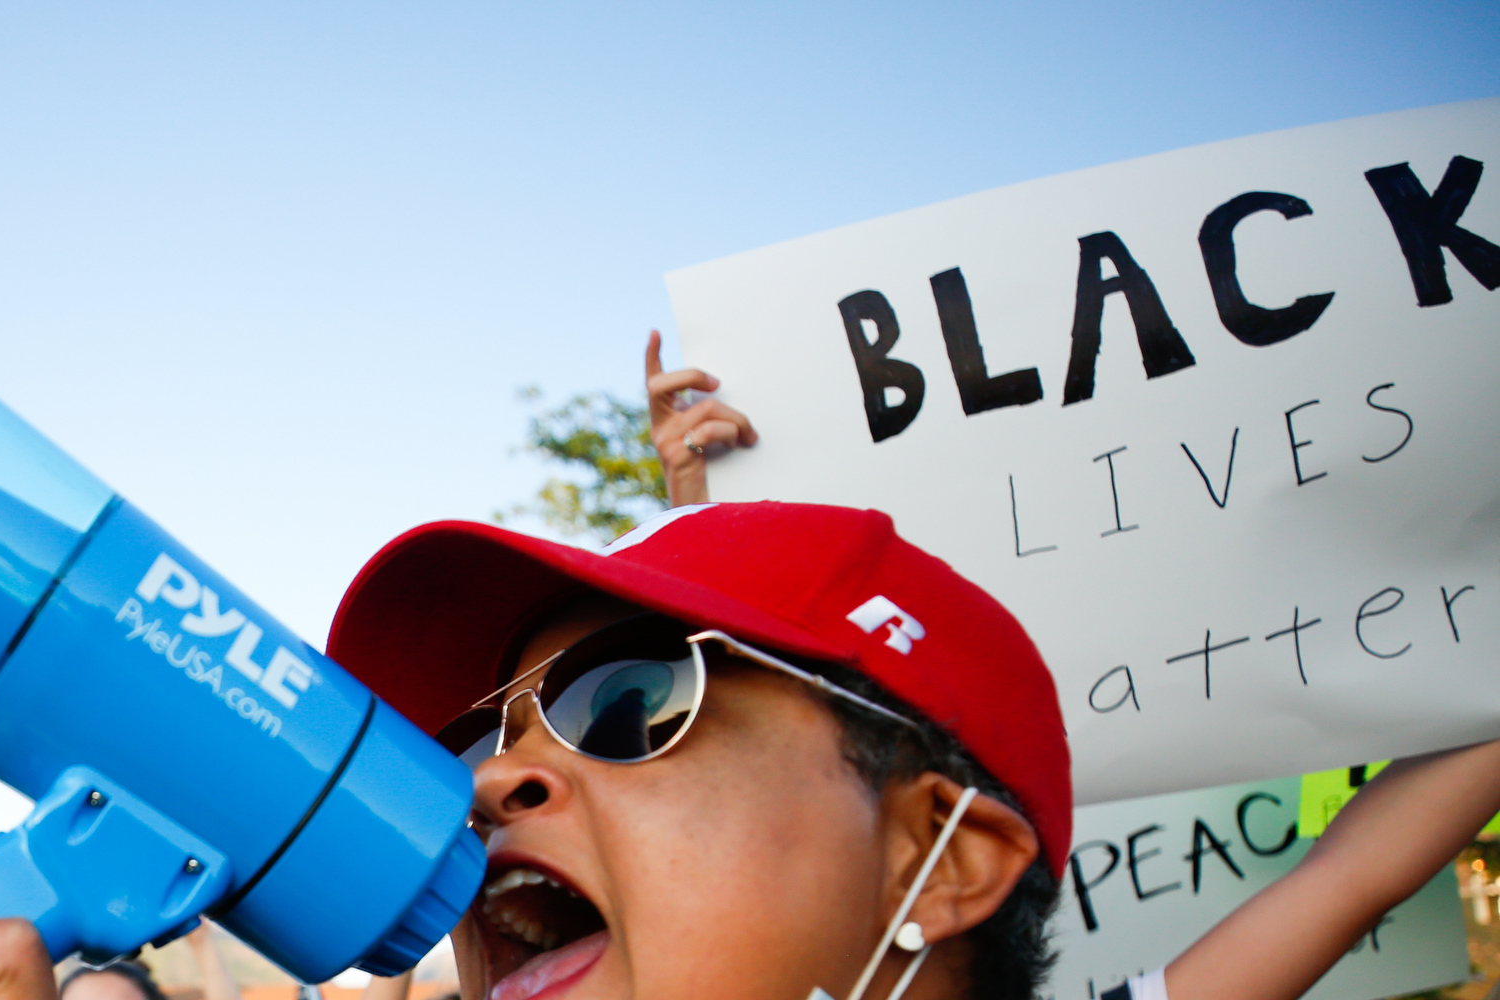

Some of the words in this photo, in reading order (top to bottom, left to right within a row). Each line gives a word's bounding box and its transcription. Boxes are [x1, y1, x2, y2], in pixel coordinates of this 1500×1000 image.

[837, 154, 1500, 444] BLACK
[1008, 382, 1415, 558] LIVES
[114, 597, 282, 738] PyleUSA.com
[135, 551, 315, 711] PYLE
[1088, 584, 1476, 714] atter
[1065, 791, 1299, 932] PEAC
